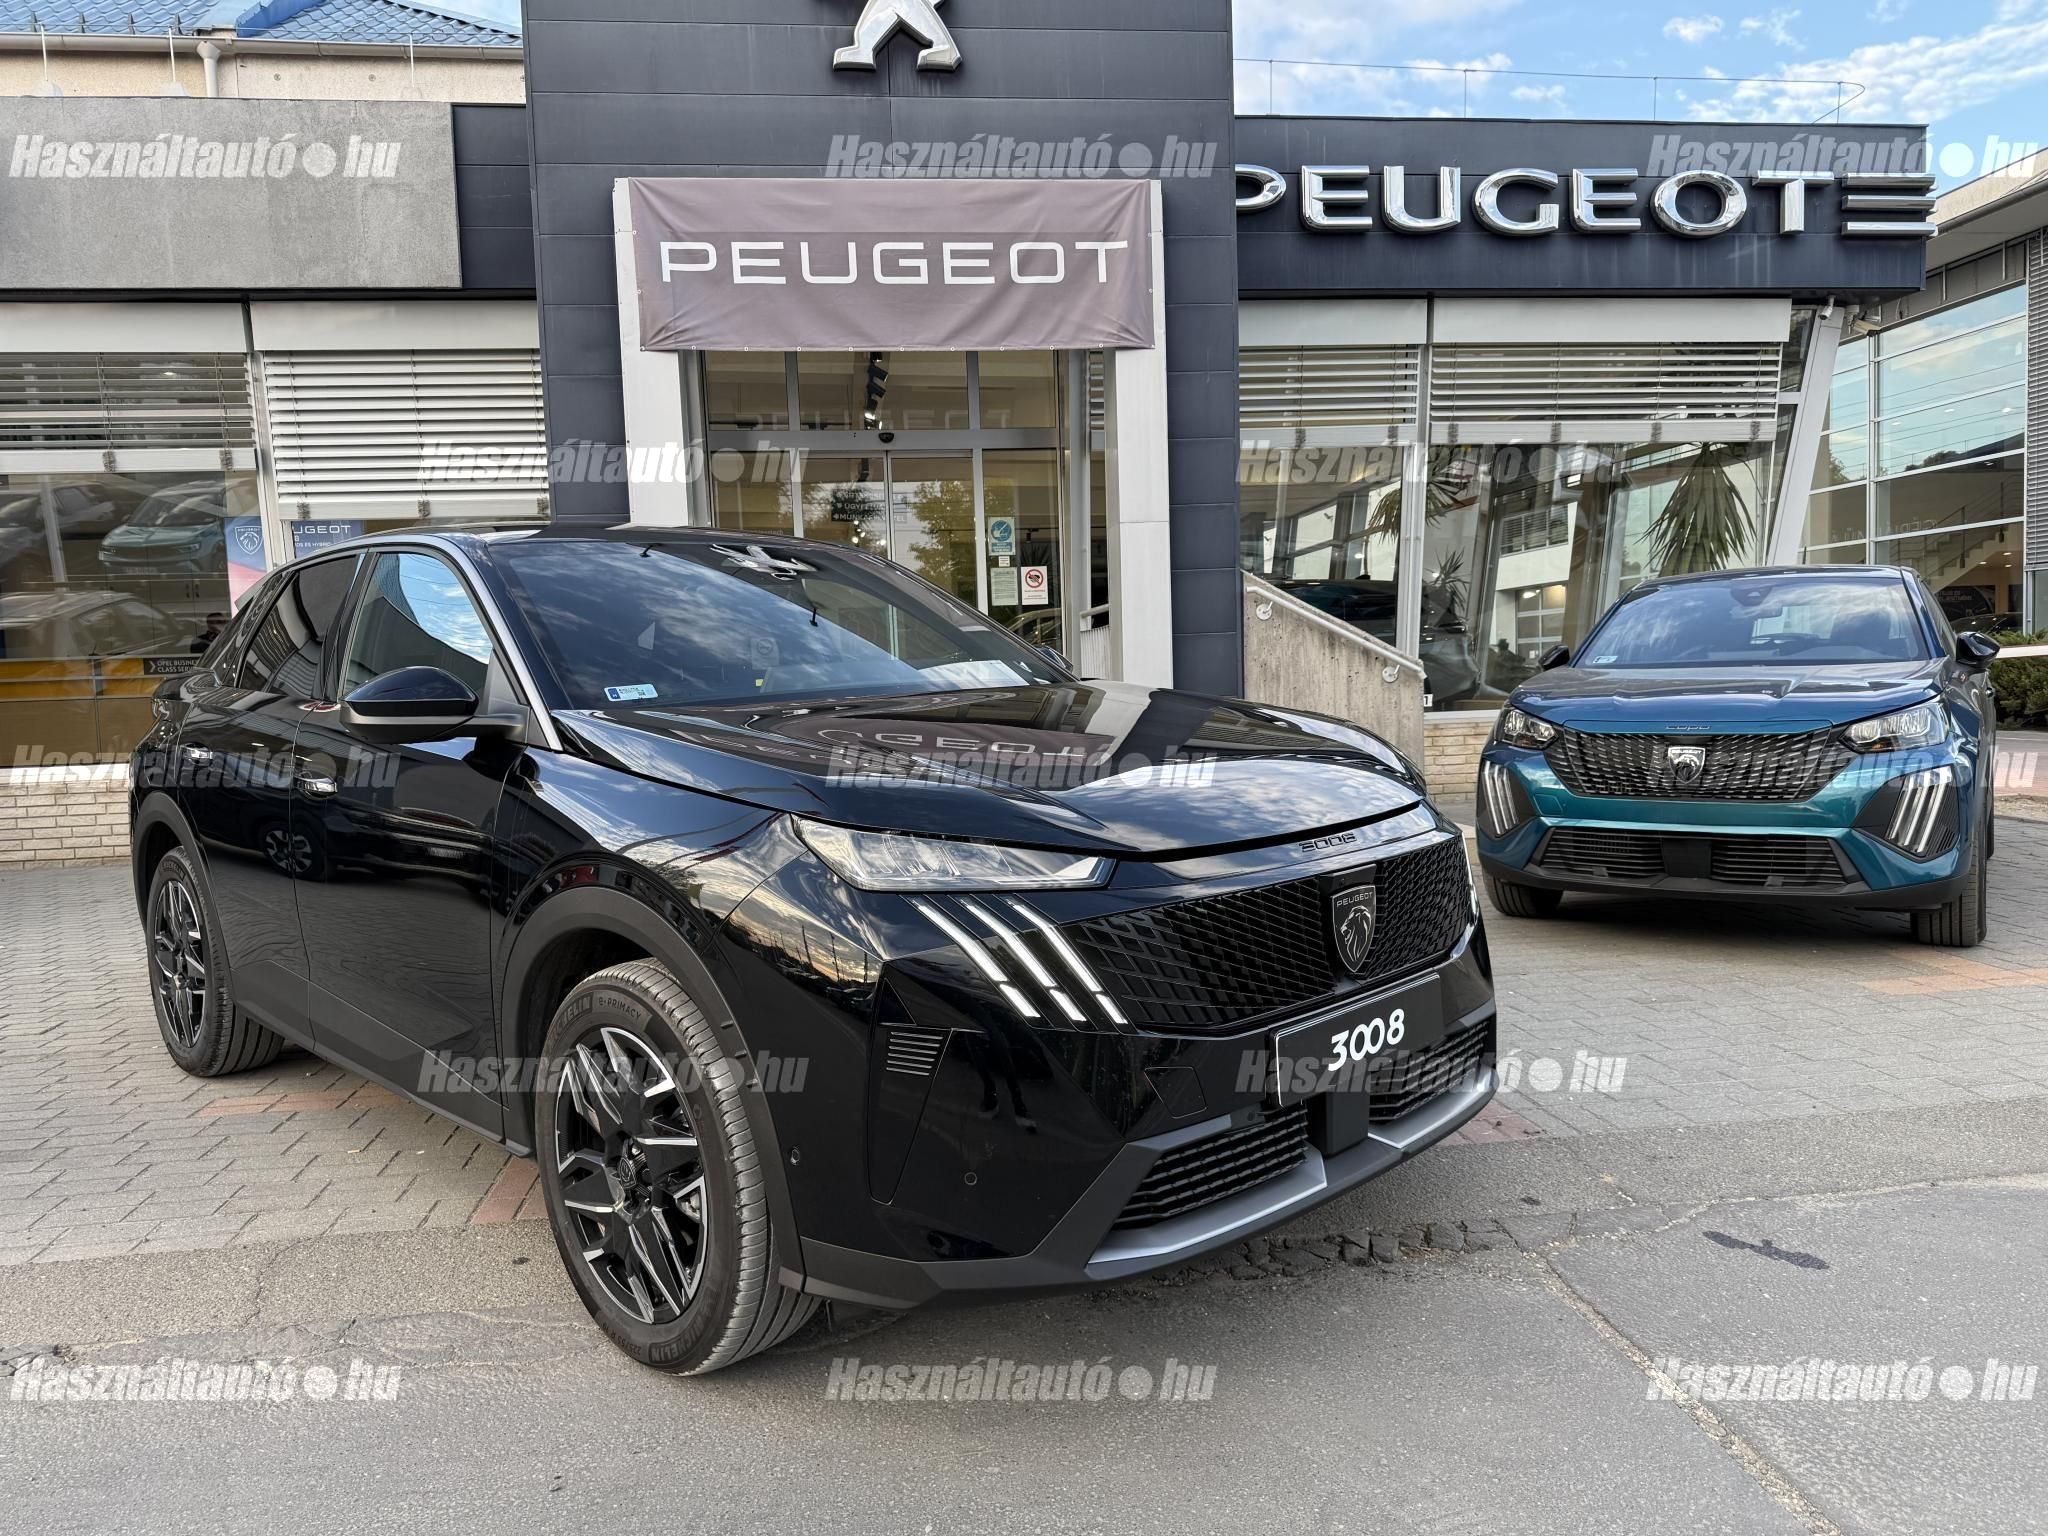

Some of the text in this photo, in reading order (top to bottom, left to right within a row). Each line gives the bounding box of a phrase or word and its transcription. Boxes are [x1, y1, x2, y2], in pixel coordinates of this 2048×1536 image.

[660, 240, 1128, 285] PEUGEOT
[1336, 891, 1374, 908] PEUGEOT
[1327, 1008, 1405, 1072] 3008
